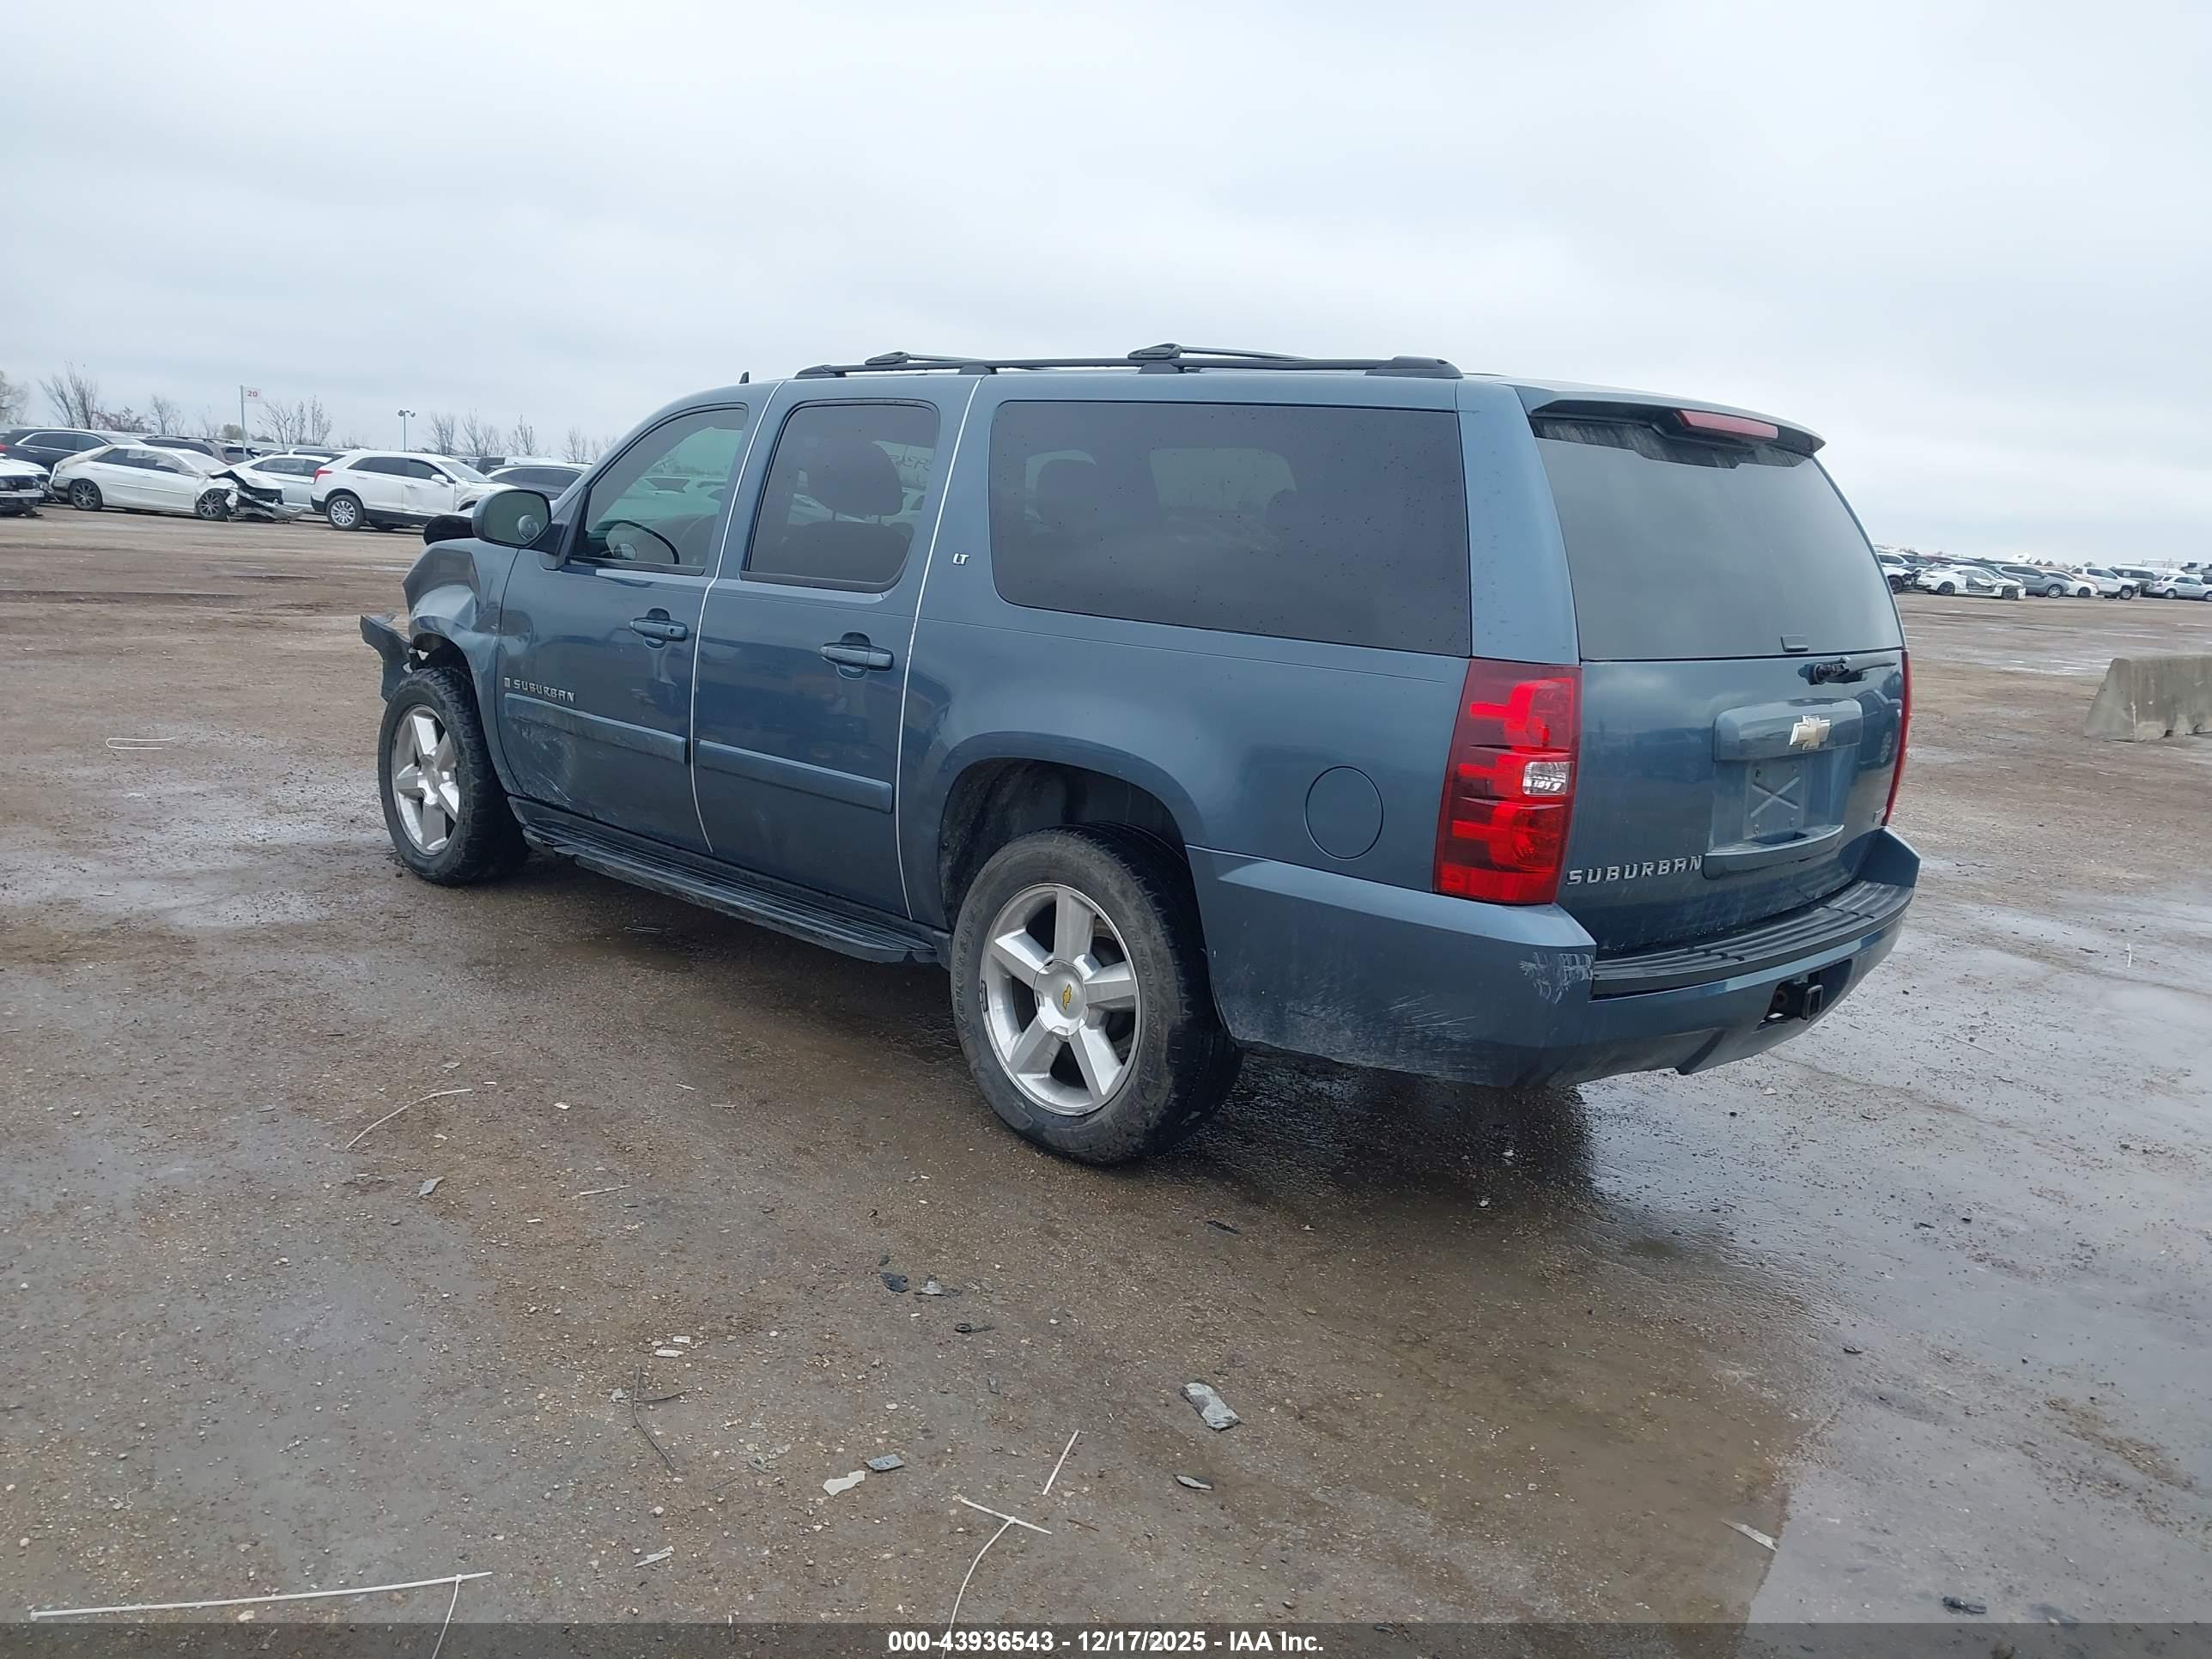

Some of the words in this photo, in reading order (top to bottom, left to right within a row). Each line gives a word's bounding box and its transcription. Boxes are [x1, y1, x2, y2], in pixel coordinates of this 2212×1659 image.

[952, 553, 969, 565] LT
[514, 678, 575, 702] SUBURBAN
[1566, 854, 1703, 886] SUBURBAN
